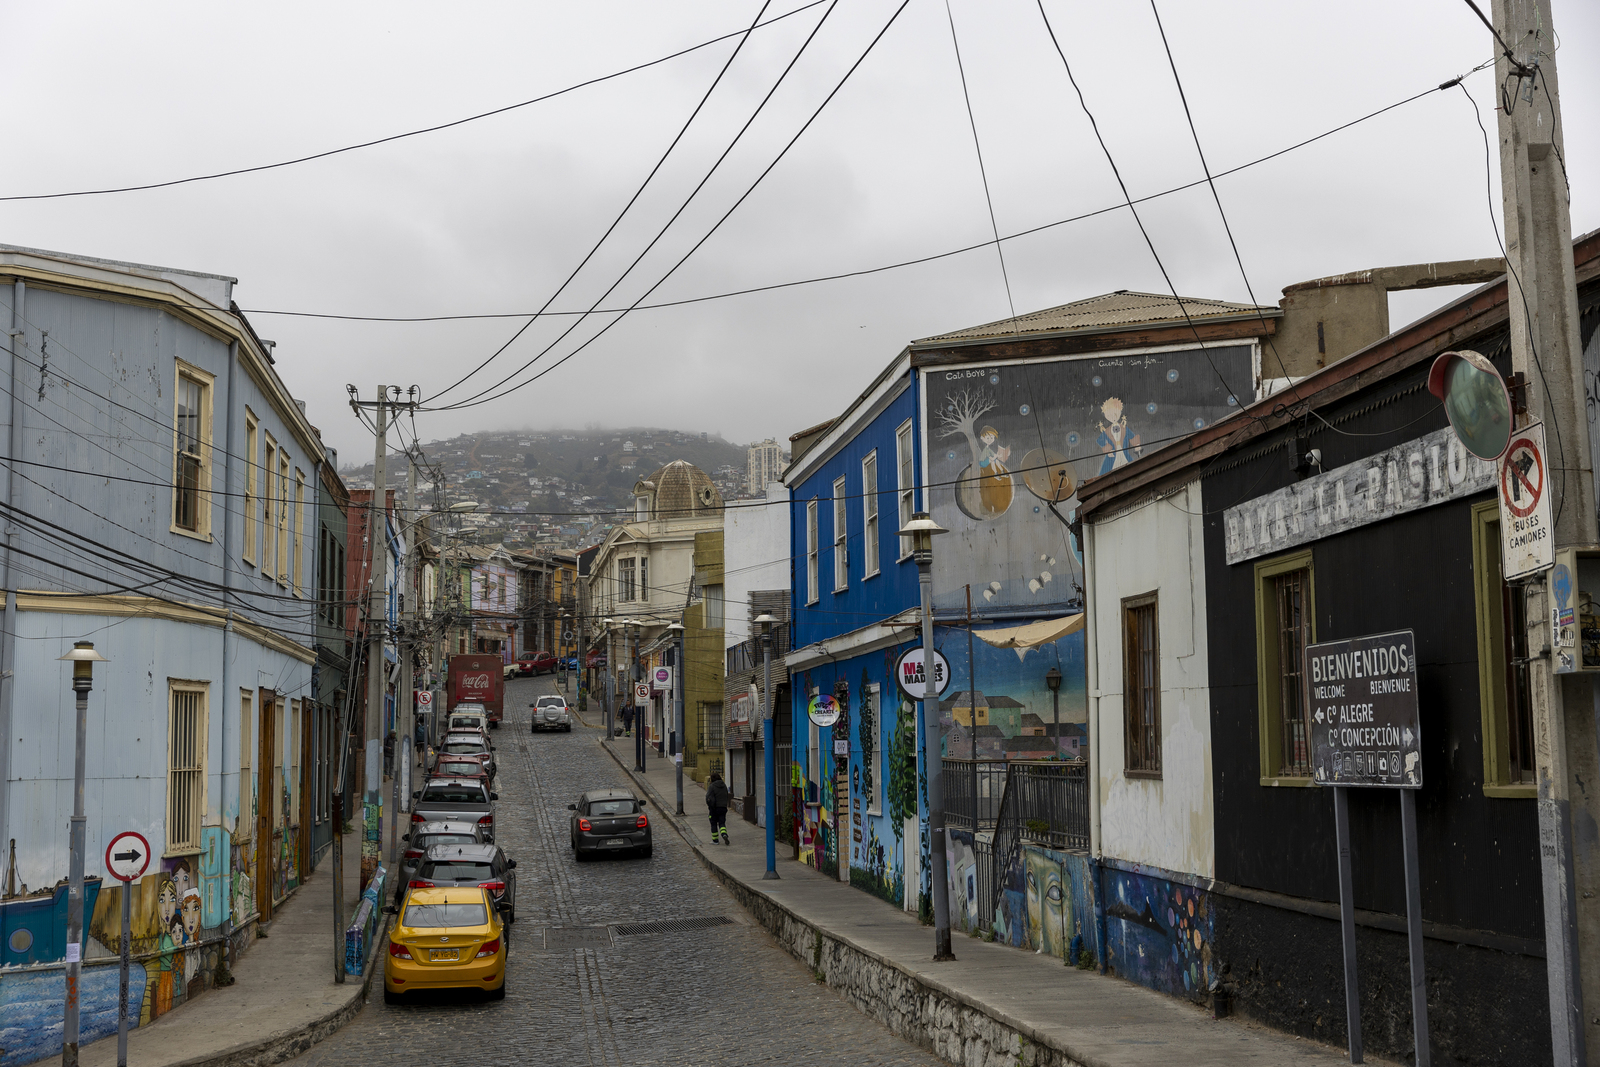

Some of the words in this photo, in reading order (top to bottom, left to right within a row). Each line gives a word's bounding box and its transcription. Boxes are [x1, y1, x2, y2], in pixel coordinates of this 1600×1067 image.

[1315, 479, 1350, 525] LA
[1515, 514, 1539, 532] BUSES
[1509, 526, 1547, 549] CAMIONES
[1312, 643, 1409, 683] BIENVENIDOS
[904, 672, 943, 684] MADES
[1314, 684, 1346, 699] WELCOME
[1370, 678, 1411, 695] BIENVENUE
[1340, 703, 1374, 723] ALEGRE
[1341, 722, 1400, 747] CONCEPCIÓN
